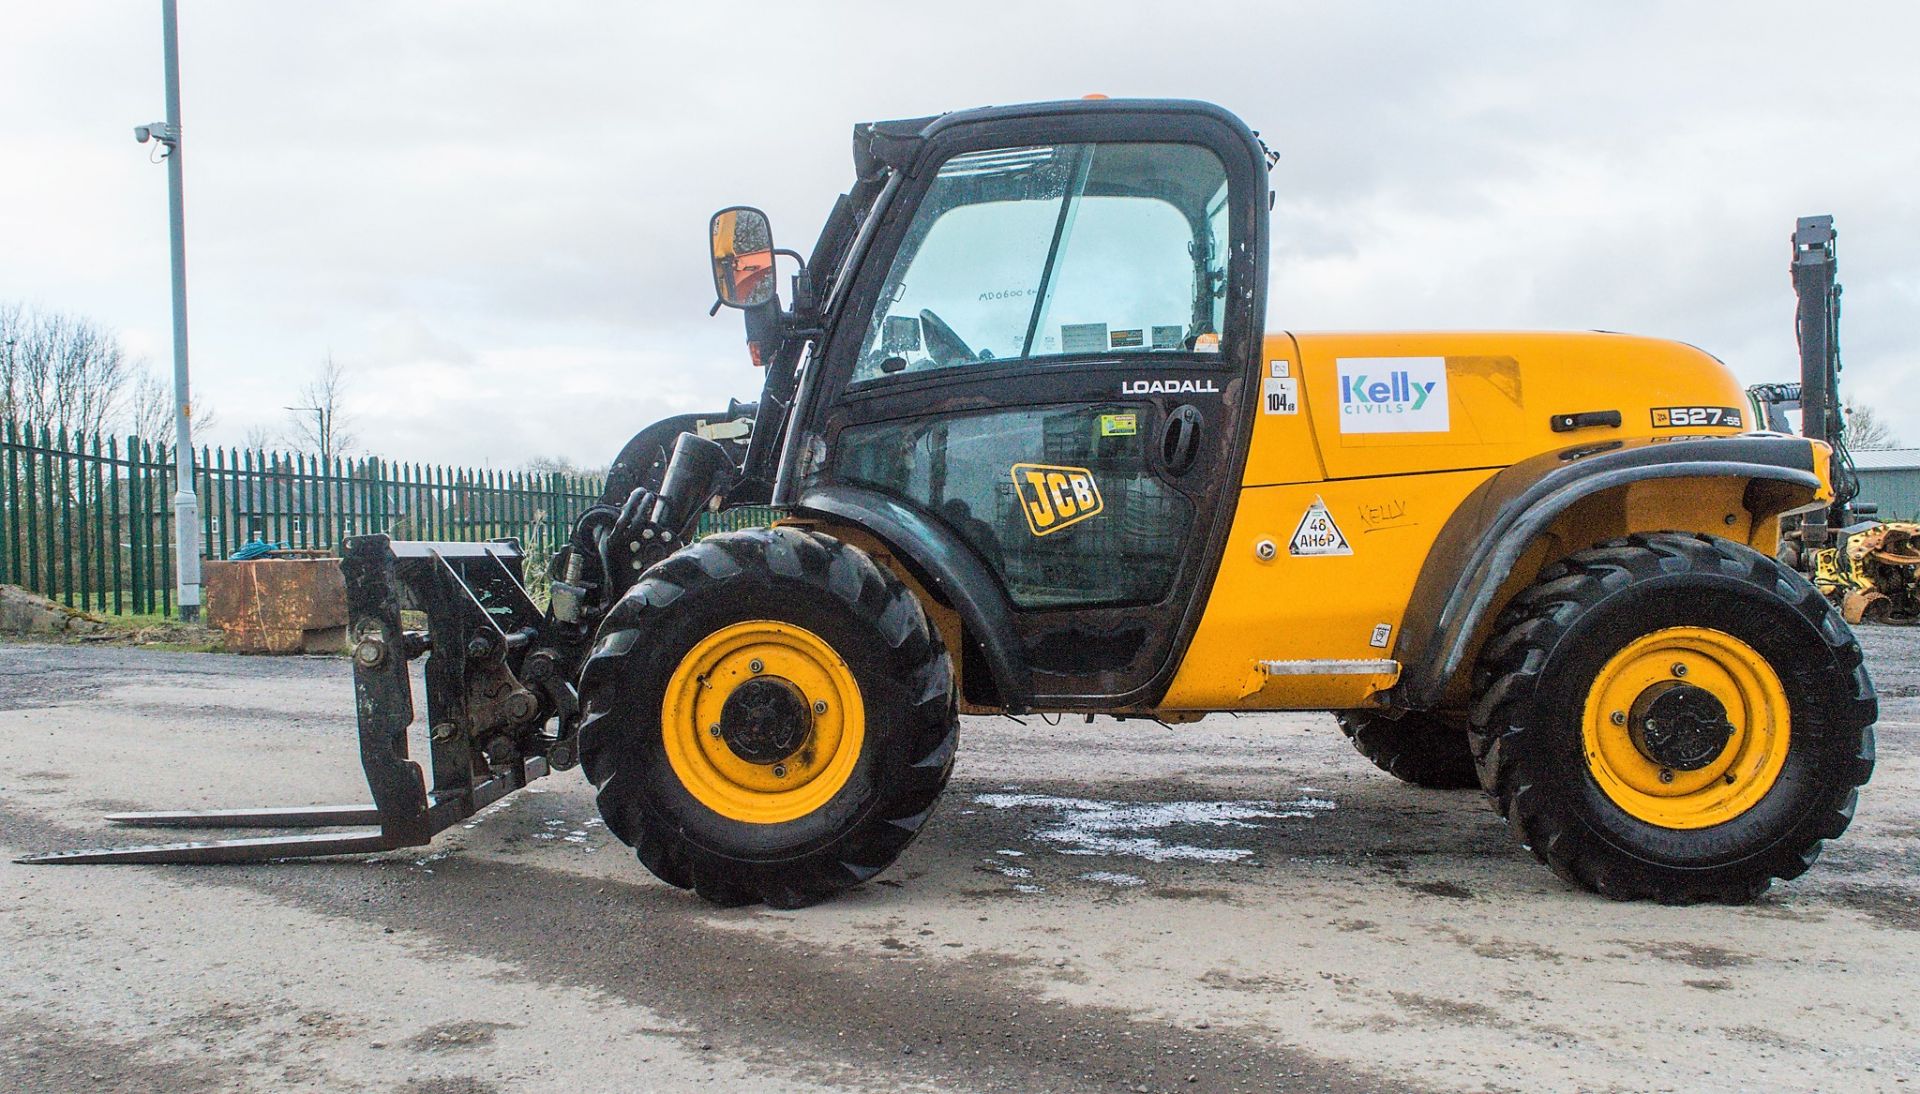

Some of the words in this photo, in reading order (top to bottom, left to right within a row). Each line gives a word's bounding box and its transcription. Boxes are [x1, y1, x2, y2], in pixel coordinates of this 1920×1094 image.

[1122, 380, 1219, 394] LOADALL
[1342, 371, 1436, 410] Kelly
[1267, 393, 1287, 411] 104
[1344, 403, 1403, 414] CIVILS
[1025, 471, 1095, 527] JCB
[1310, 518, 1327, 532] 48
